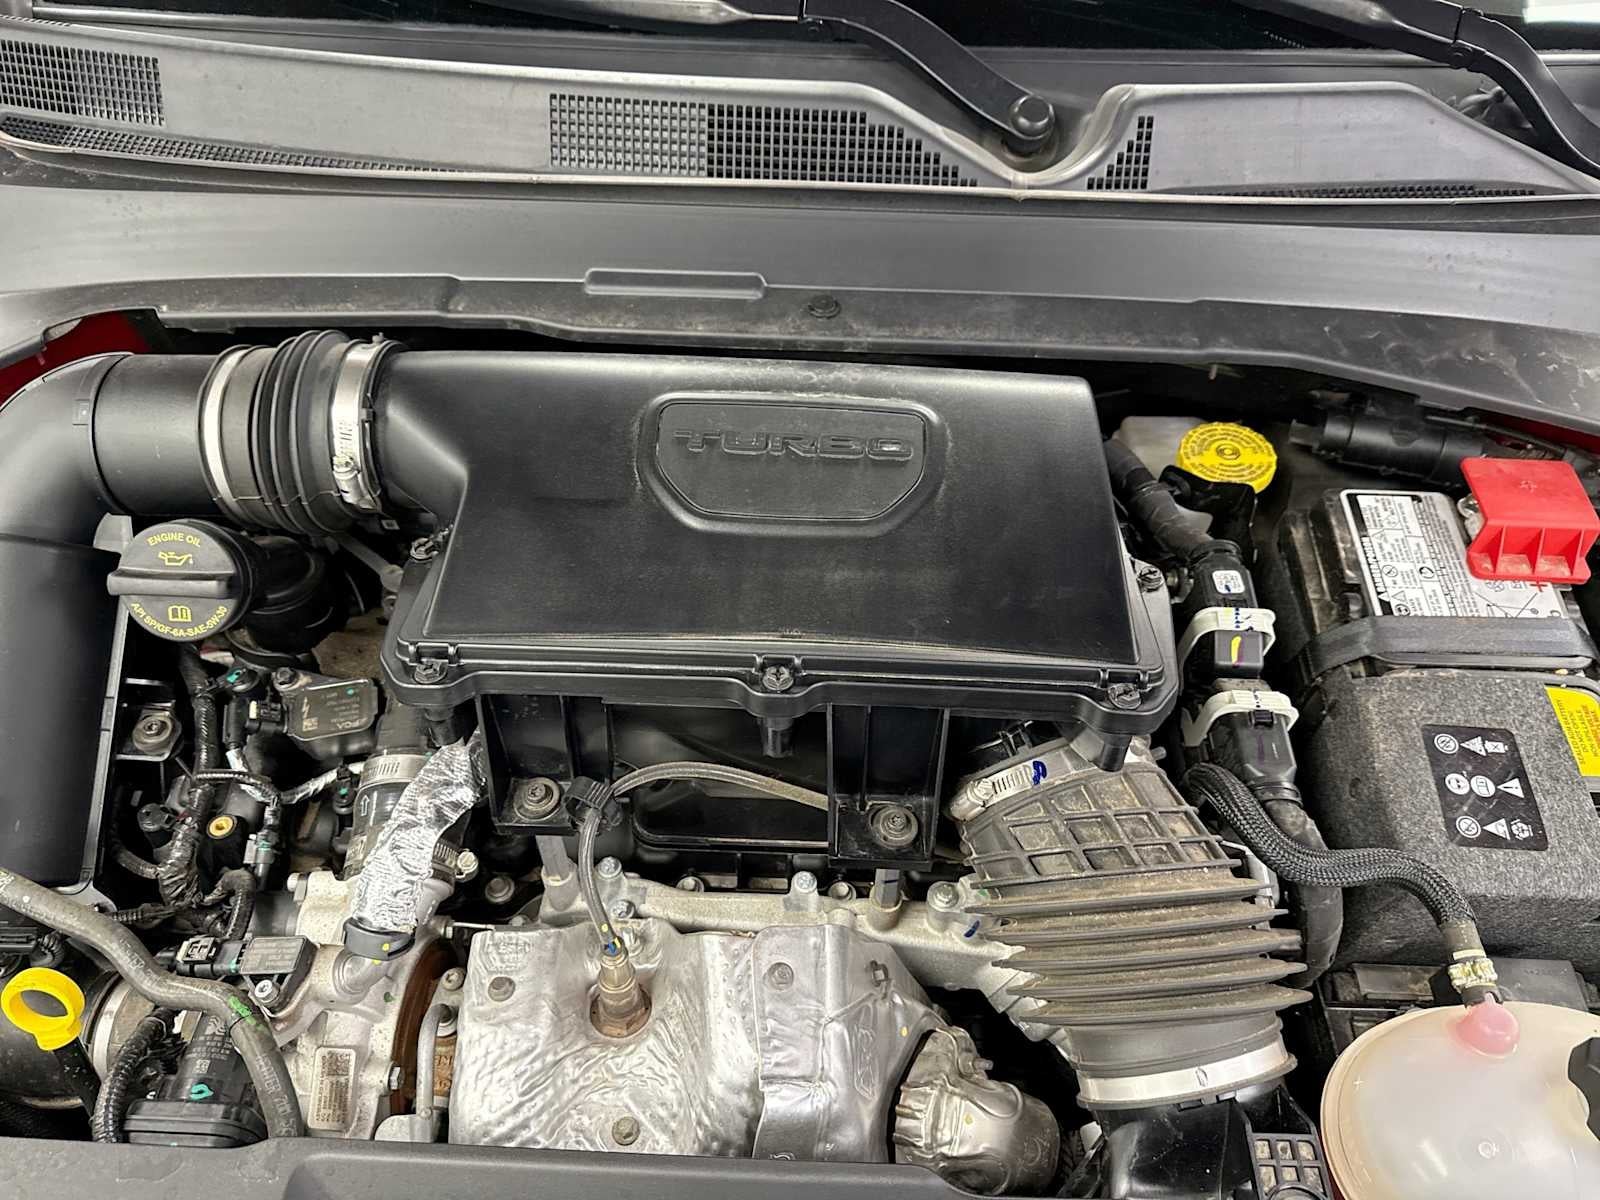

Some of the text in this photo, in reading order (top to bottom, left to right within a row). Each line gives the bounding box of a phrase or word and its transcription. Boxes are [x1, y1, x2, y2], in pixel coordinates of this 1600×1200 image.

[673, 430, 913, 461] TURBO
[148, 532, 201, 548] ENGINE OIL
[130, 602, 146, 618] API
